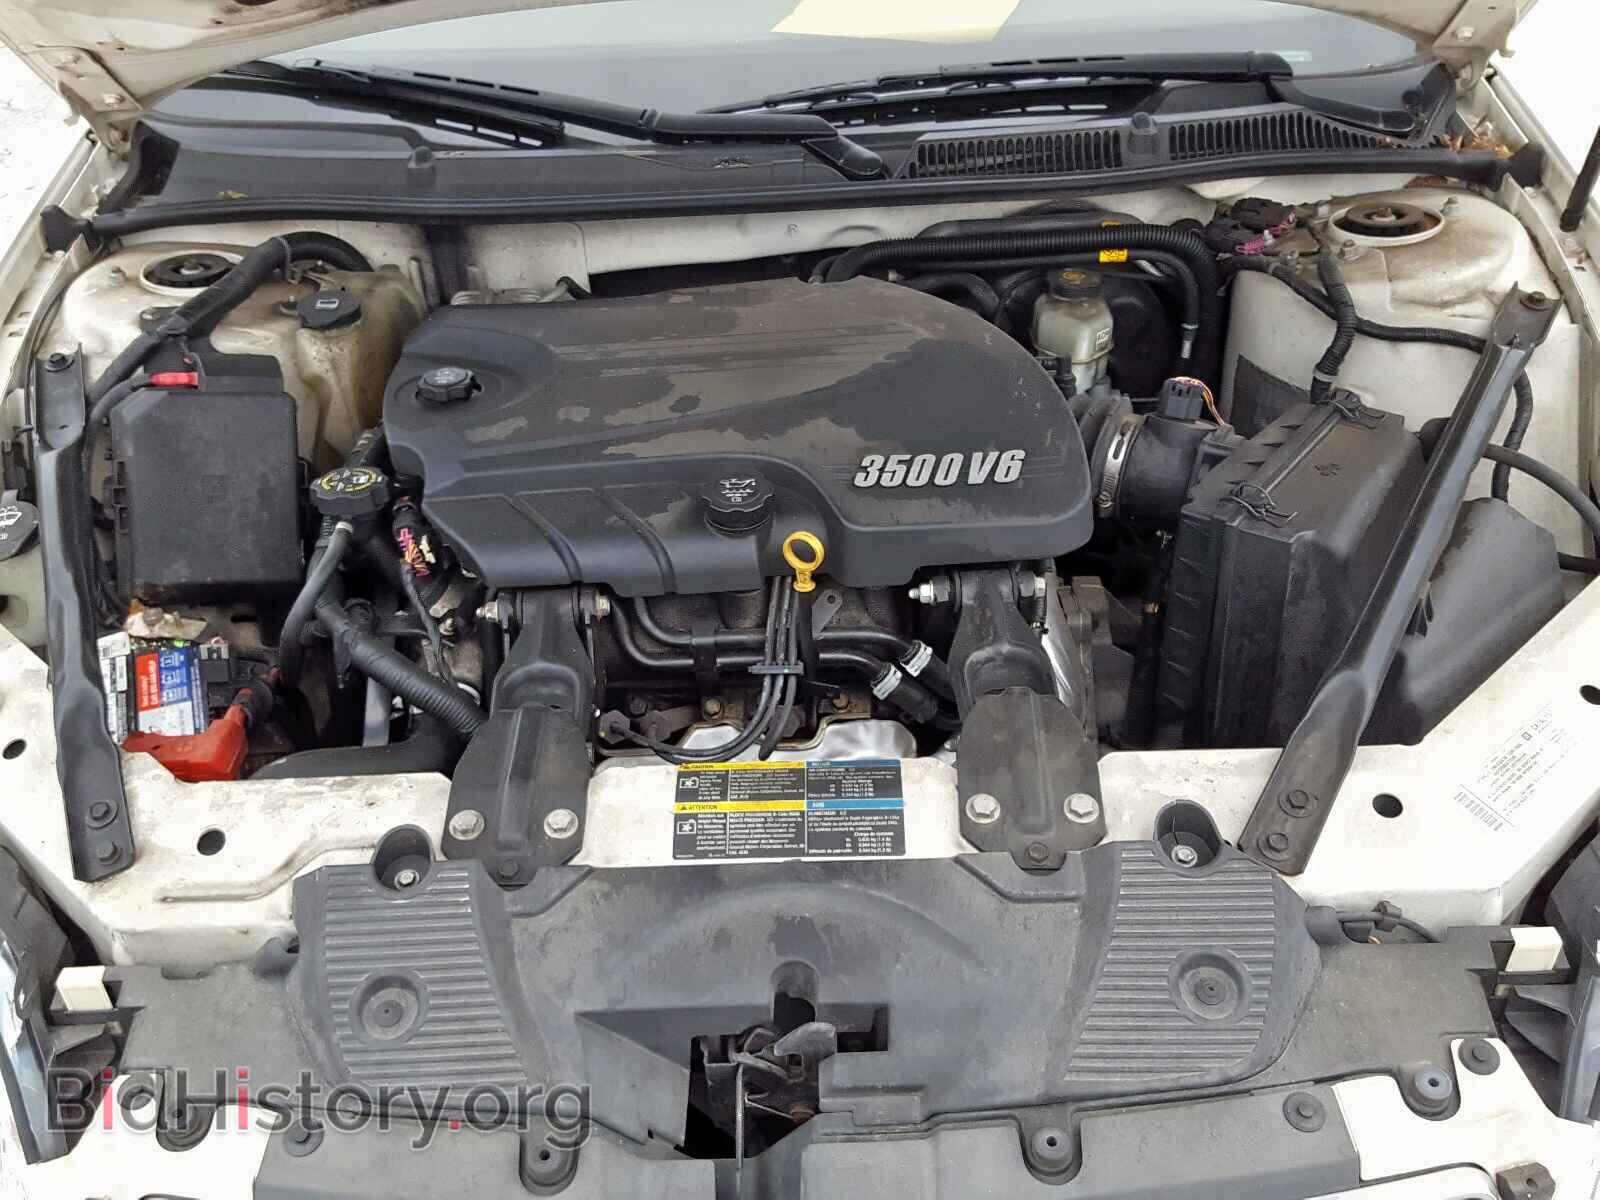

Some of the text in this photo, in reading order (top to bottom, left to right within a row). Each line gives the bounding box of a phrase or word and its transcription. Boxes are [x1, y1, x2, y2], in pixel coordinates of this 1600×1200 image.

[854, 449, 1026, 488] 3500 V6
[688, 803, 718, 811] ATTENTION
